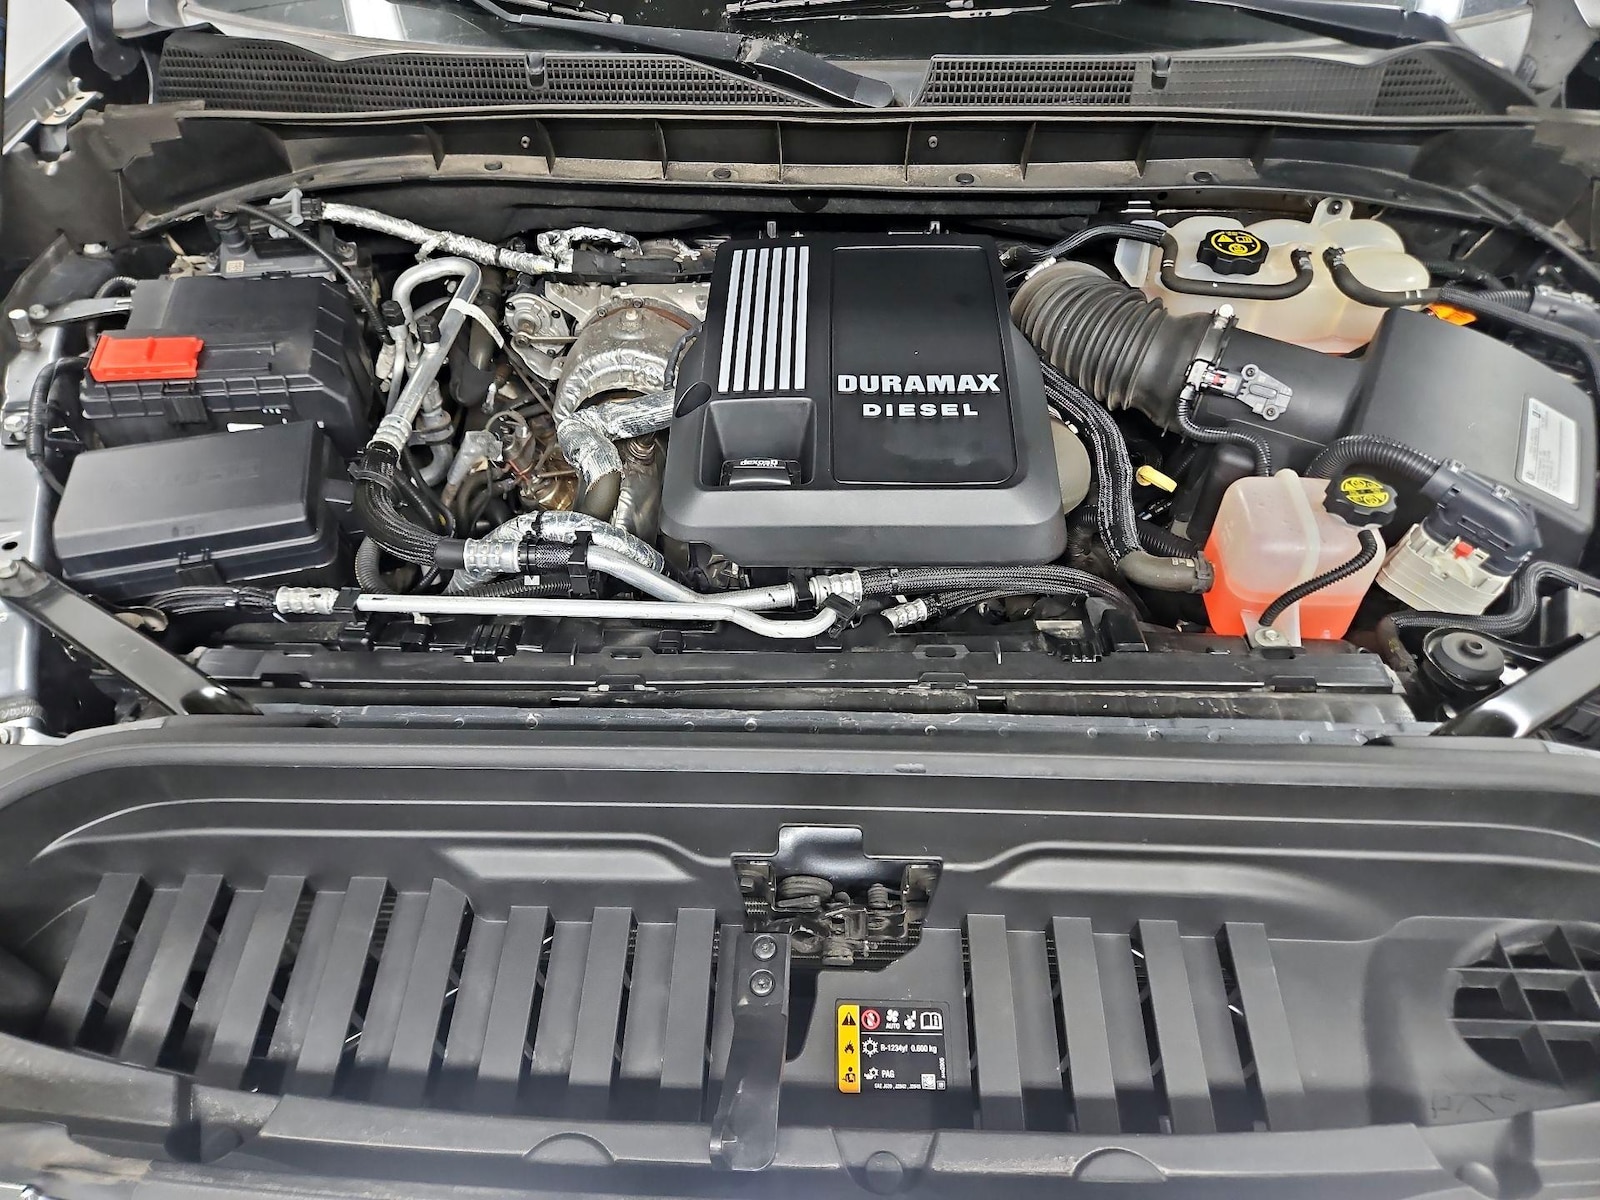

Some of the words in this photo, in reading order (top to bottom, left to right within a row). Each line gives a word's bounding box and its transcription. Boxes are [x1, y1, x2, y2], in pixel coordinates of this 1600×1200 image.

[837, 374, 1000, 394] DURAMAX
[862, 403, 978, 418] DIESEL
[929, 1044, 938, 1054] kg
[881, 1069, 895, 1078] PAG
